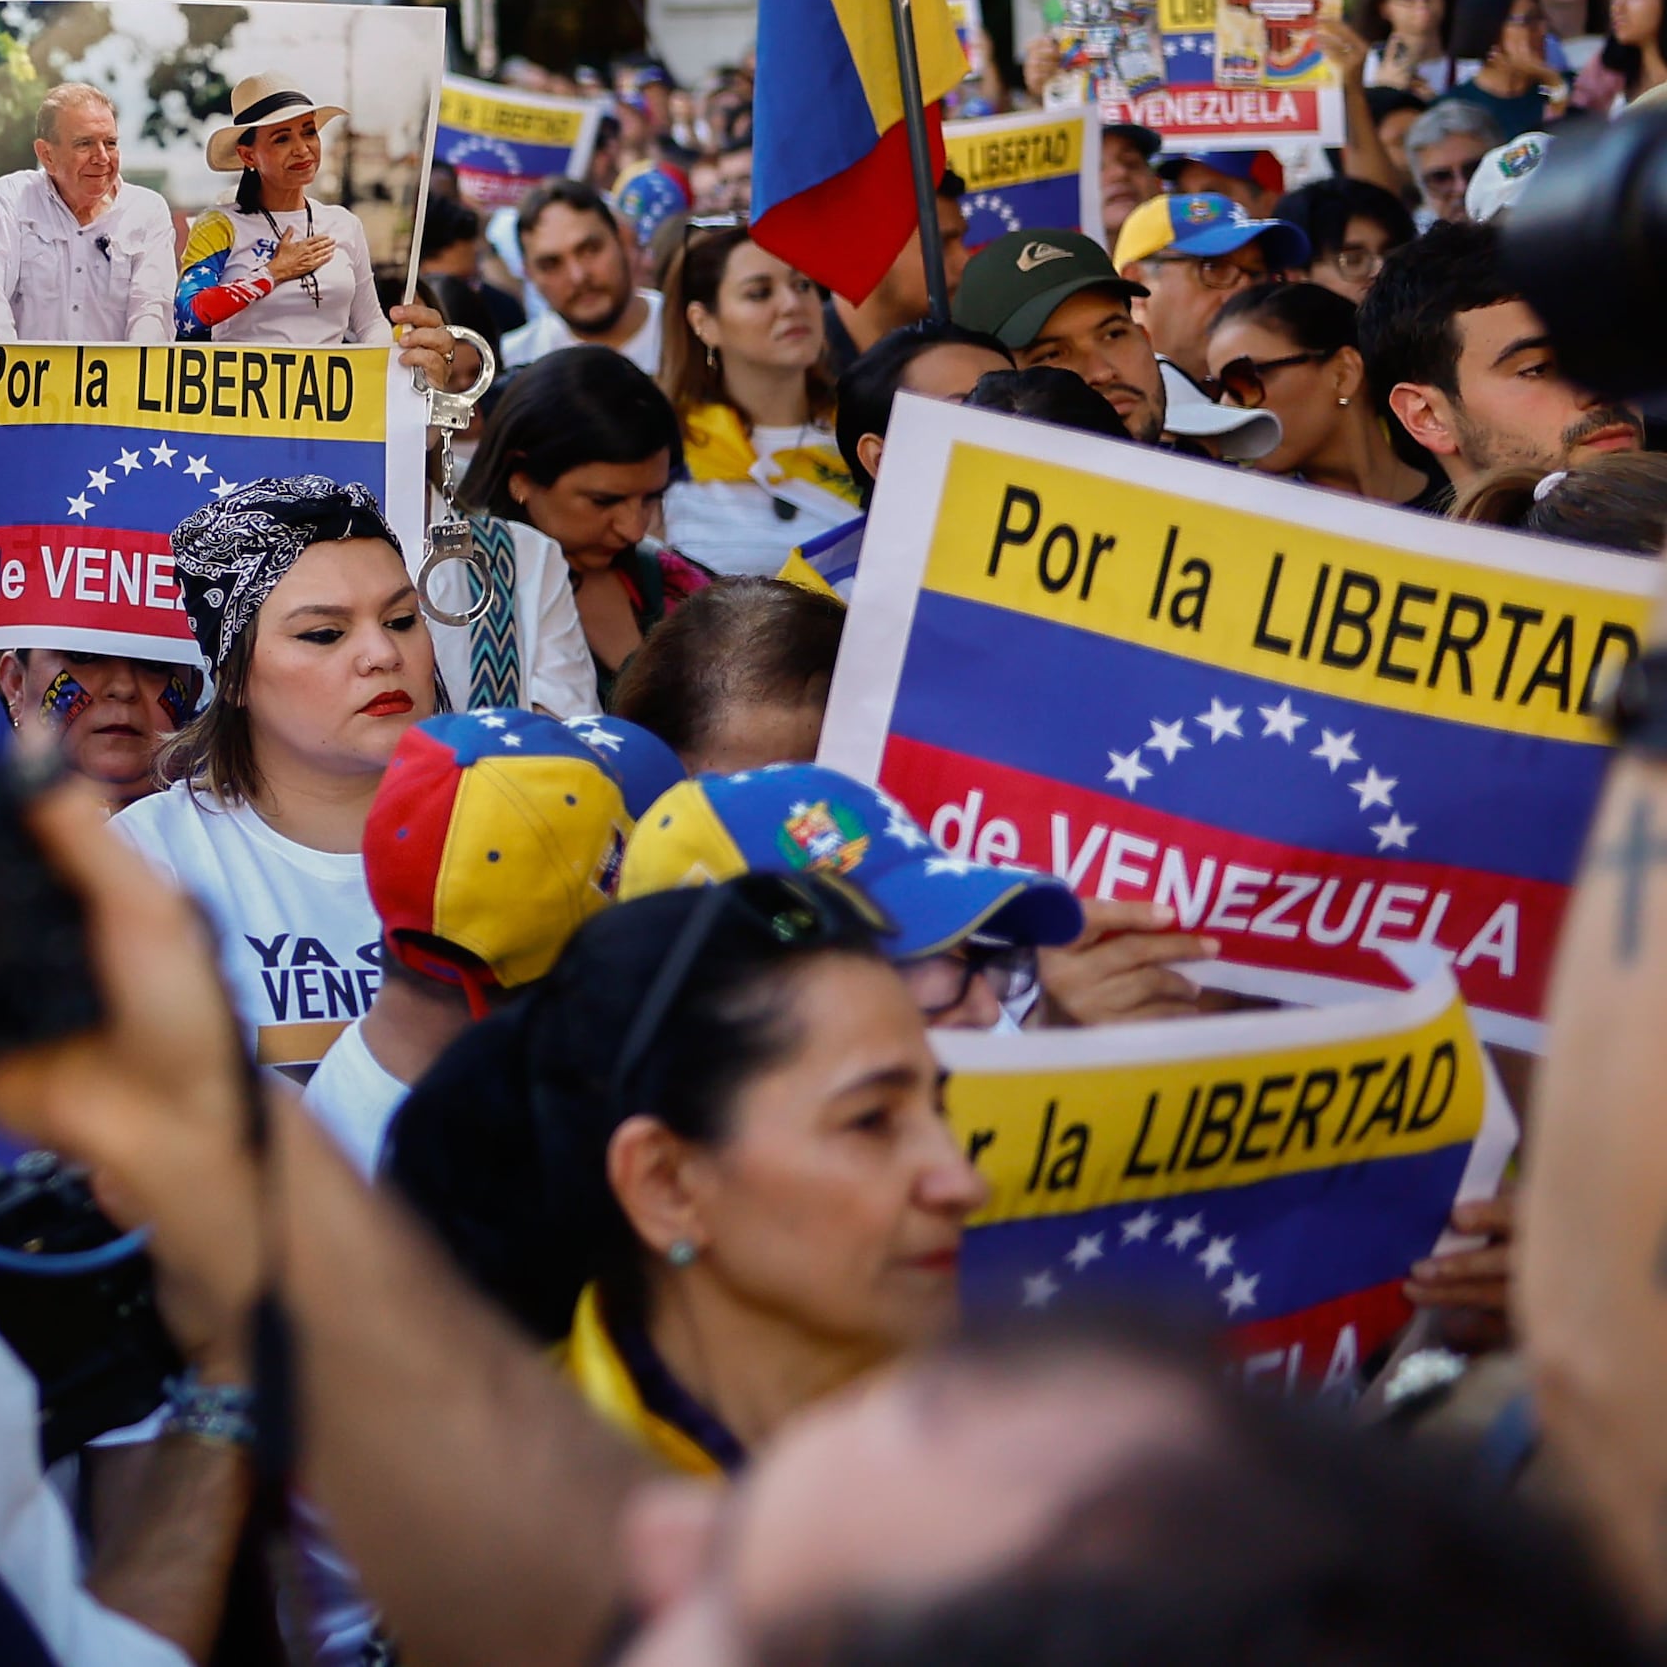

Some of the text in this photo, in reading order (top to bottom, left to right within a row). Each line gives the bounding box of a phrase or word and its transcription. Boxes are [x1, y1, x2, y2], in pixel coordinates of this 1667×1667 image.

[1131, 89, 1300, 126] VENEZUELA
[967, 128, 1069, 181] LIBERTAD
[74, 345, 109, 409] la
[137, 345, 355, 423] LIBERTAD
[41, 545, 185, 611] VENE
[986, 484, 1641, 717] Por la LIBERTAD
[929, 788, 1520, 979] de VENEZUELA
[243, 933, 341, 968] YA
[1027, 1100, 1091, 1196] la
[1122, 1040, 1457, 1182] LIBERTAD
